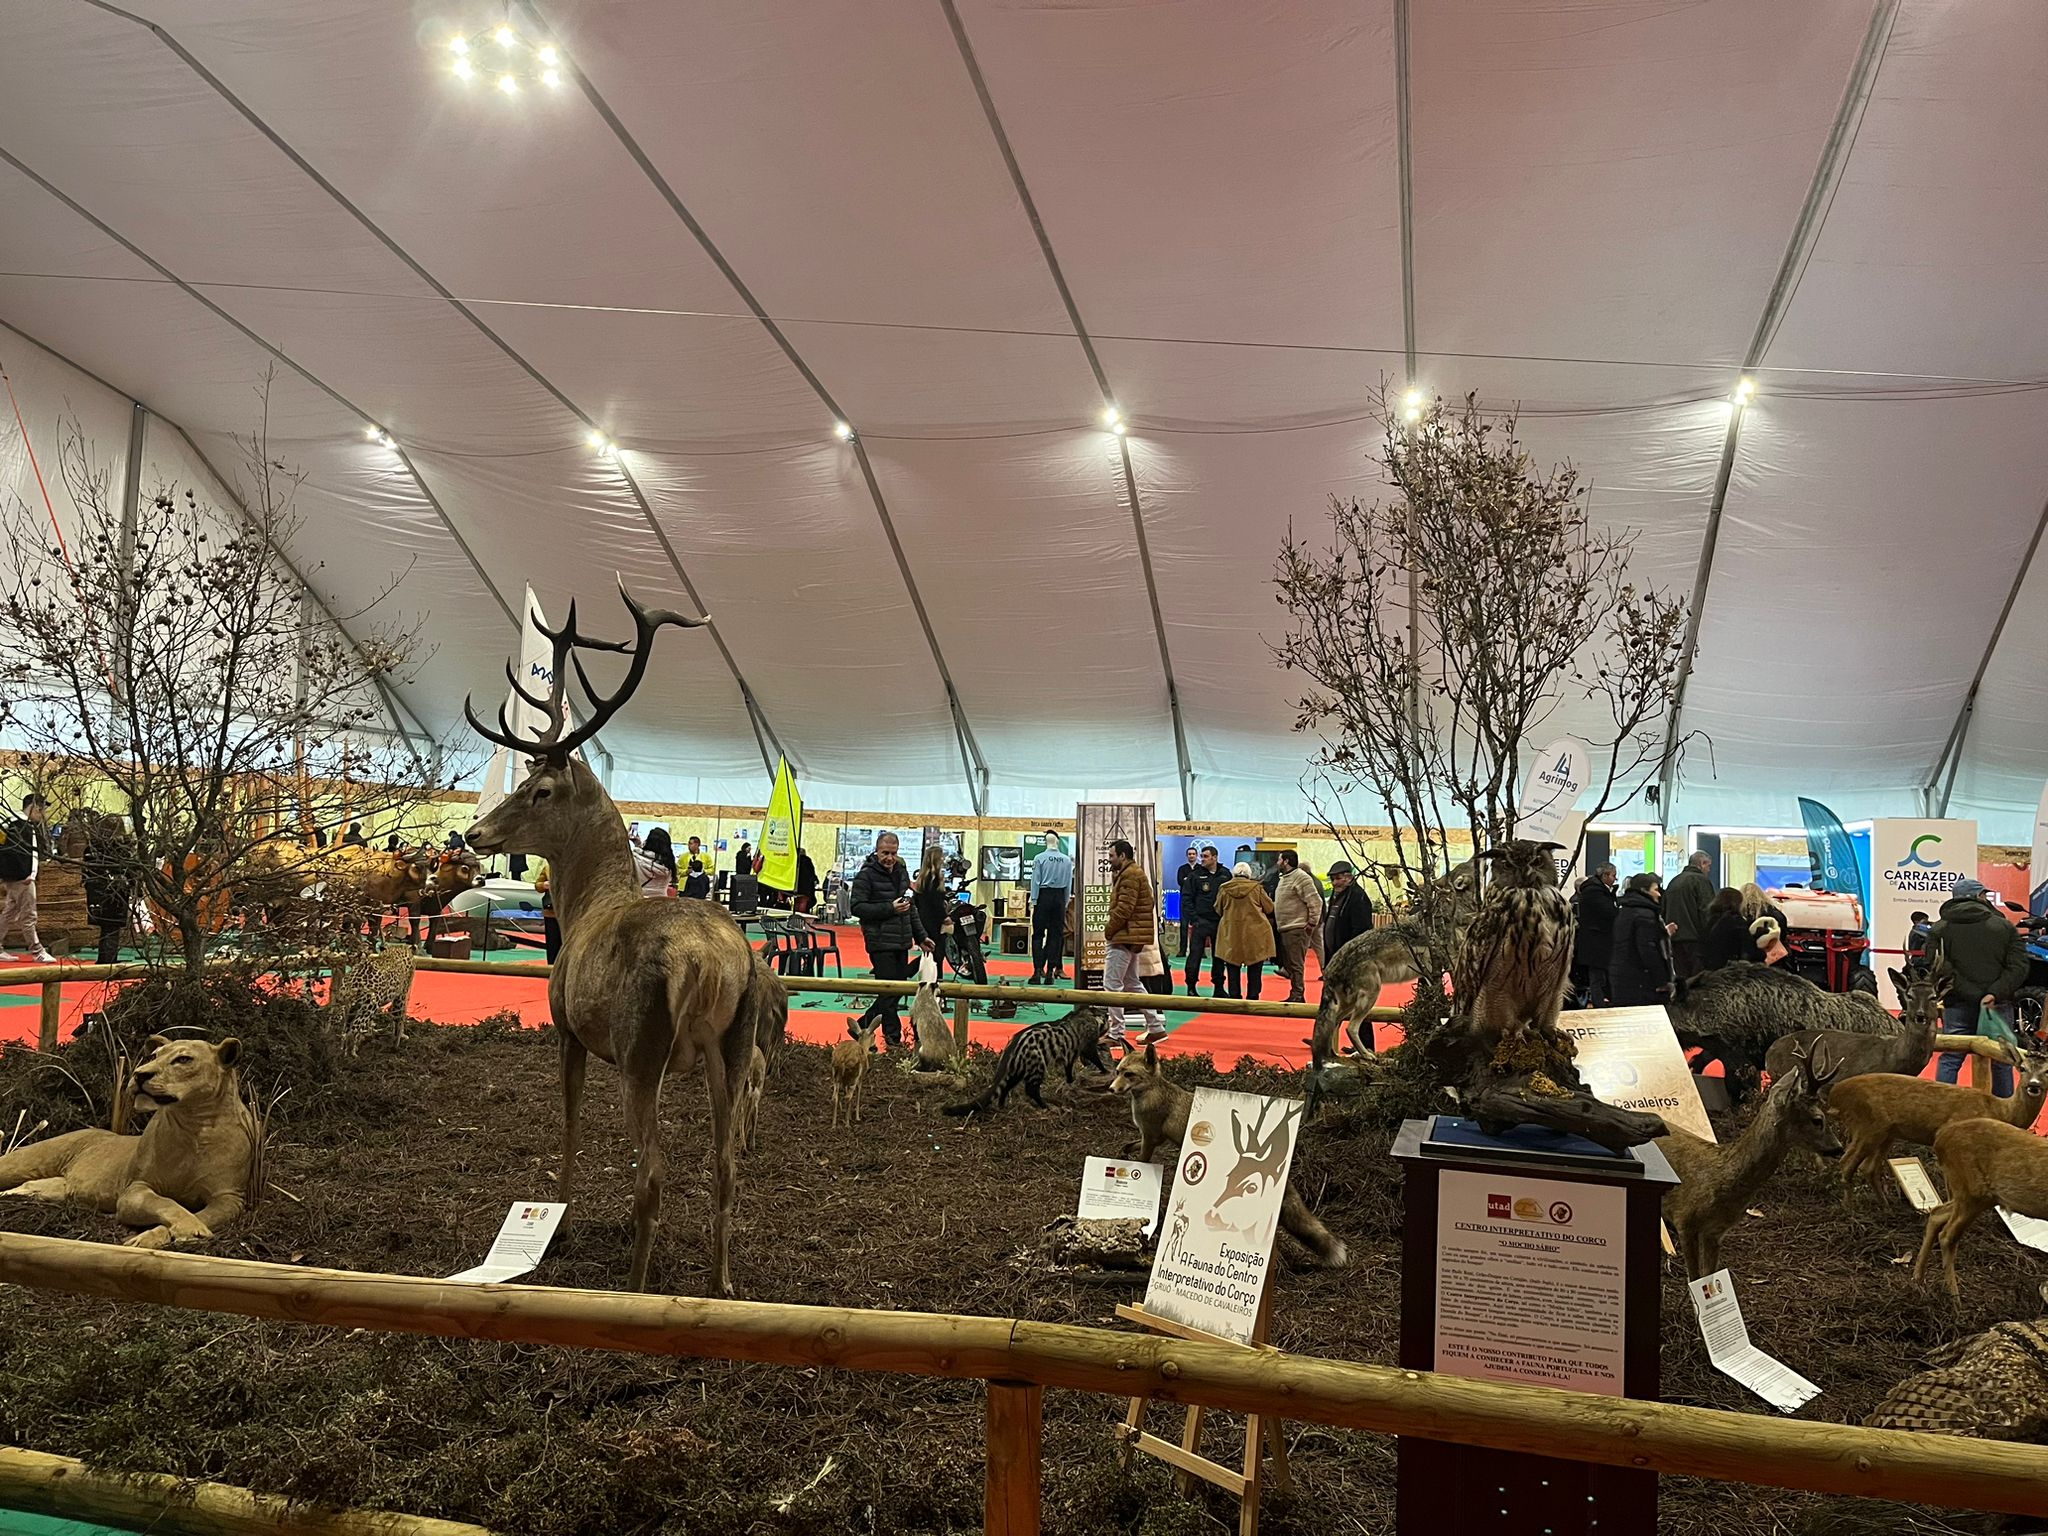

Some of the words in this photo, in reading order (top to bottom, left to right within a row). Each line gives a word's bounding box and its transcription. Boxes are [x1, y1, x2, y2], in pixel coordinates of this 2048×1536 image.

[1539, 771, 1578, 792] Agrimog
[1884, 870, 1966, 882] CARRAZEDA
[1086, 923, 1105, 932] NÃO
[1488, 1201, 1511, 1211] utad
[1455, 1221, 1488, 1233] CENTRO
[1489, 1224, 1560, 1241] INTERPRETATIVO
[1562, 1233, 1575, 1242] DO
[1220, 1243, 1264, 1268] Exposição
[1509, 1240, 1535, 1251] MOCHO
[1180, 1251, 1188, 1266] A
[1188, 1253, 1213, 1273] Fauna
[1214, 1261, 1225, 1276] do
[1227, 1263, 1258, 1285] Centro
[1158, 1264, 1214, 1293] Interpretativo
[1215, 1281, 1226, 1296] do
[1227, 1284, 1256, 1306] Corço
[1176, 1288, 1203, 1302] MACEDO
[1204, 1296, 1213, 1306] DE
[1214, 1300, 1253, 1318] CAVALEIROS
[1442, 1349, 1469, 1359] FIQUEM
[1476, 1354, 1514, 1365] CONHECER
[1522, 1360, 1545, 1368] FAUNA
[1546, 1363, 1593, 1376] PORTUGUESA
[1600, 1371, 1615, 1379] NOS
[1448, 1343, 1466, 1351] ESTE
[1478, 1347, 1501, 1356] NOSSO
[1502, 1350, 1547, 1362] CONTRIBUTO
[1548, 1356, 1567, 1365] PARA
[1568, 1359, 1583, 1368] QUE
[1585, 1361, 1609, 1371] TODOS
[1484, 1363, 1513, 1373] AJUDEM
